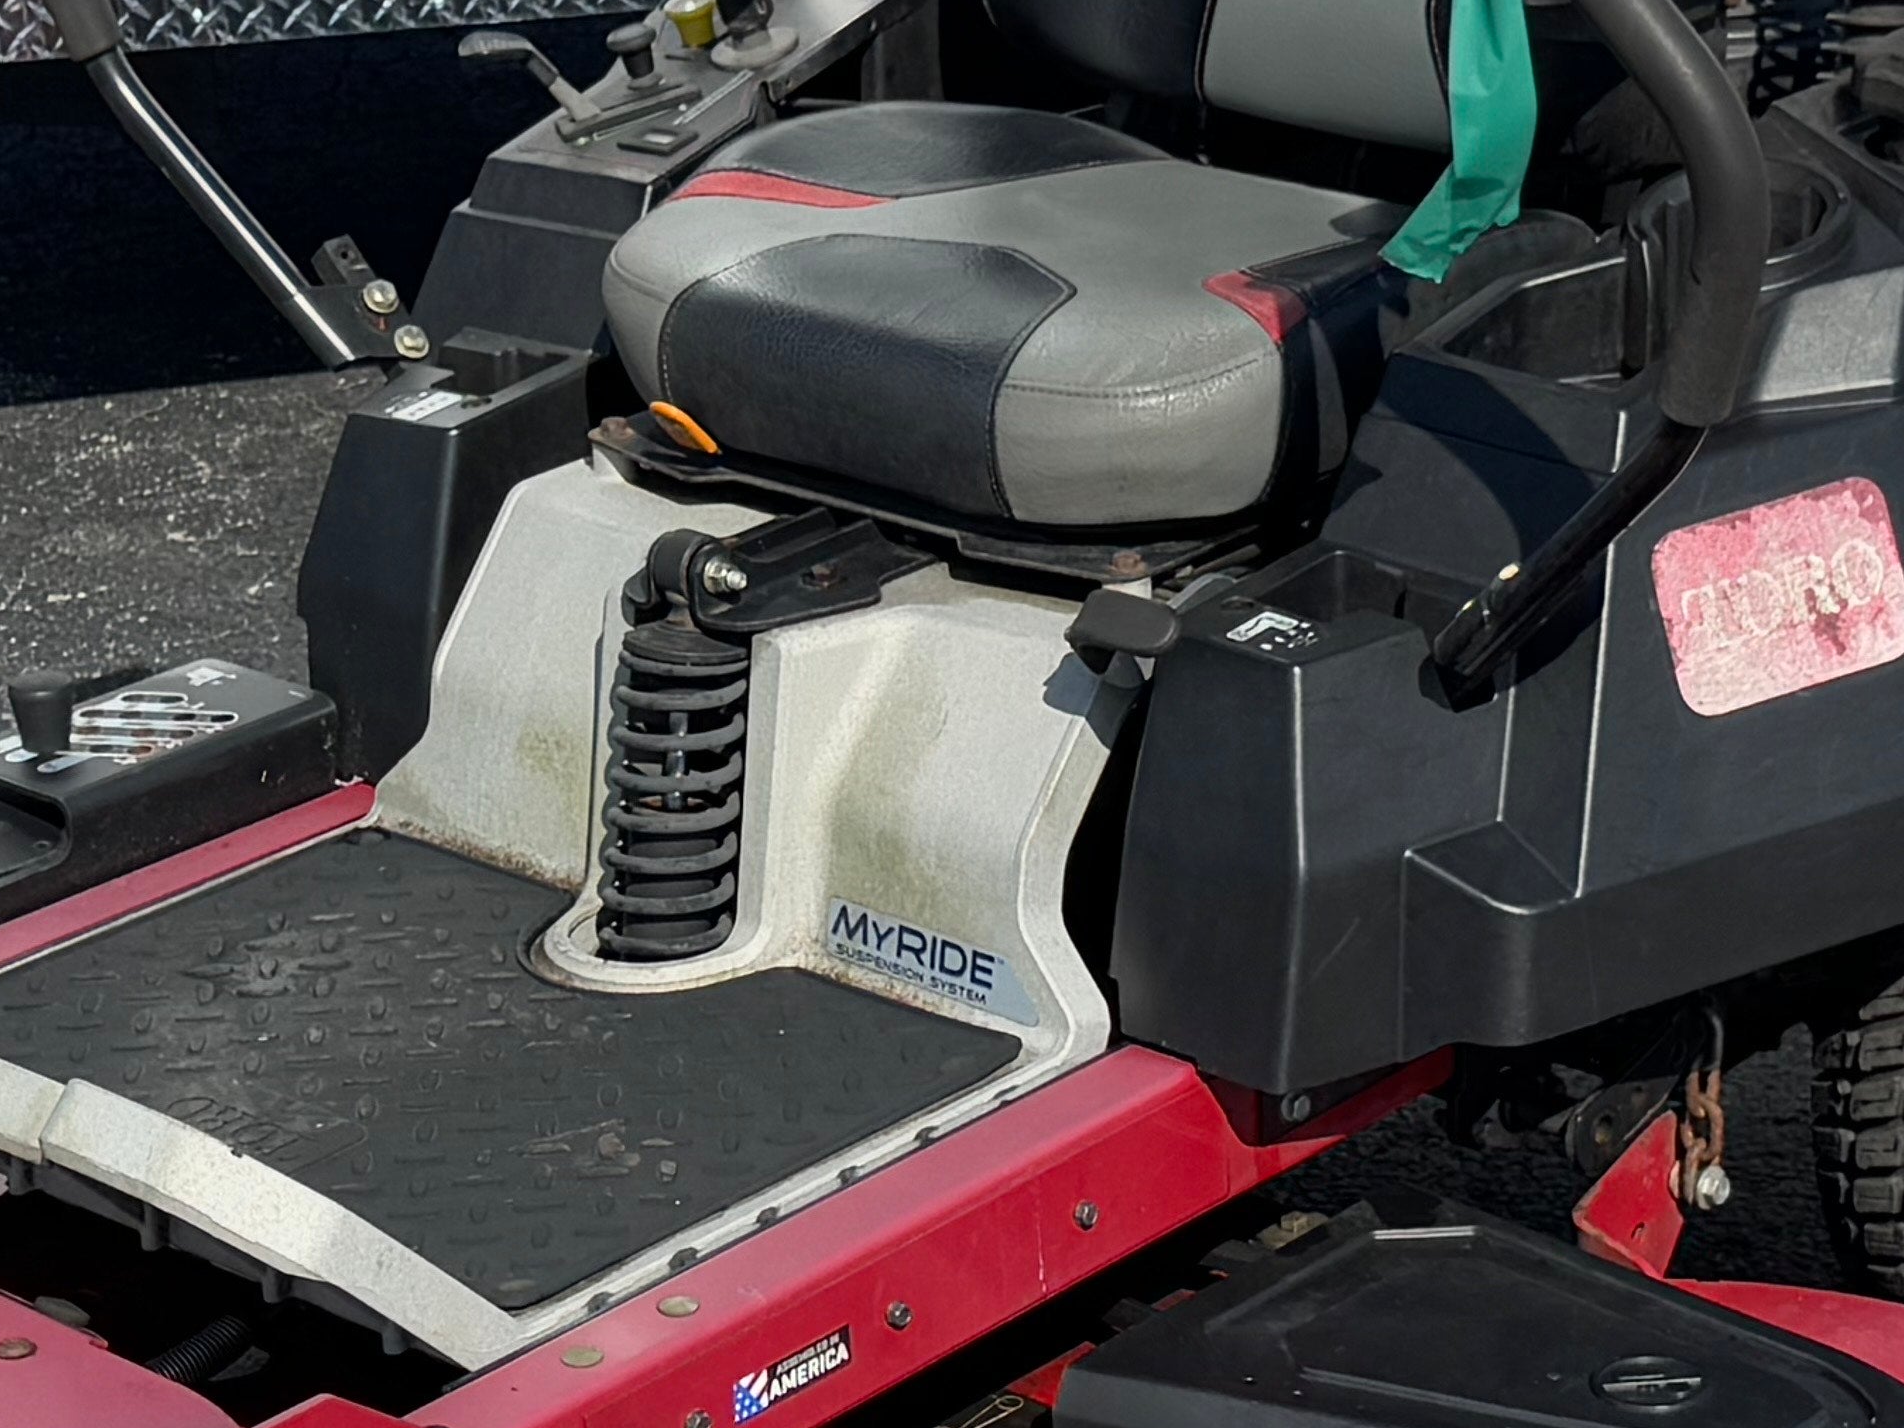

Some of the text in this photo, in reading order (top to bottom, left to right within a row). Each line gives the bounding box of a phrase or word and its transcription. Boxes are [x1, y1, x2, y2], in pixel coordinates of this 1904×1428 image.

[1681, 538, 1884, 648] TORO
[834, 942, 988, 1005] SUSPENSION SYSTEM
[770, 1341, 849, 1401] AMERICA
